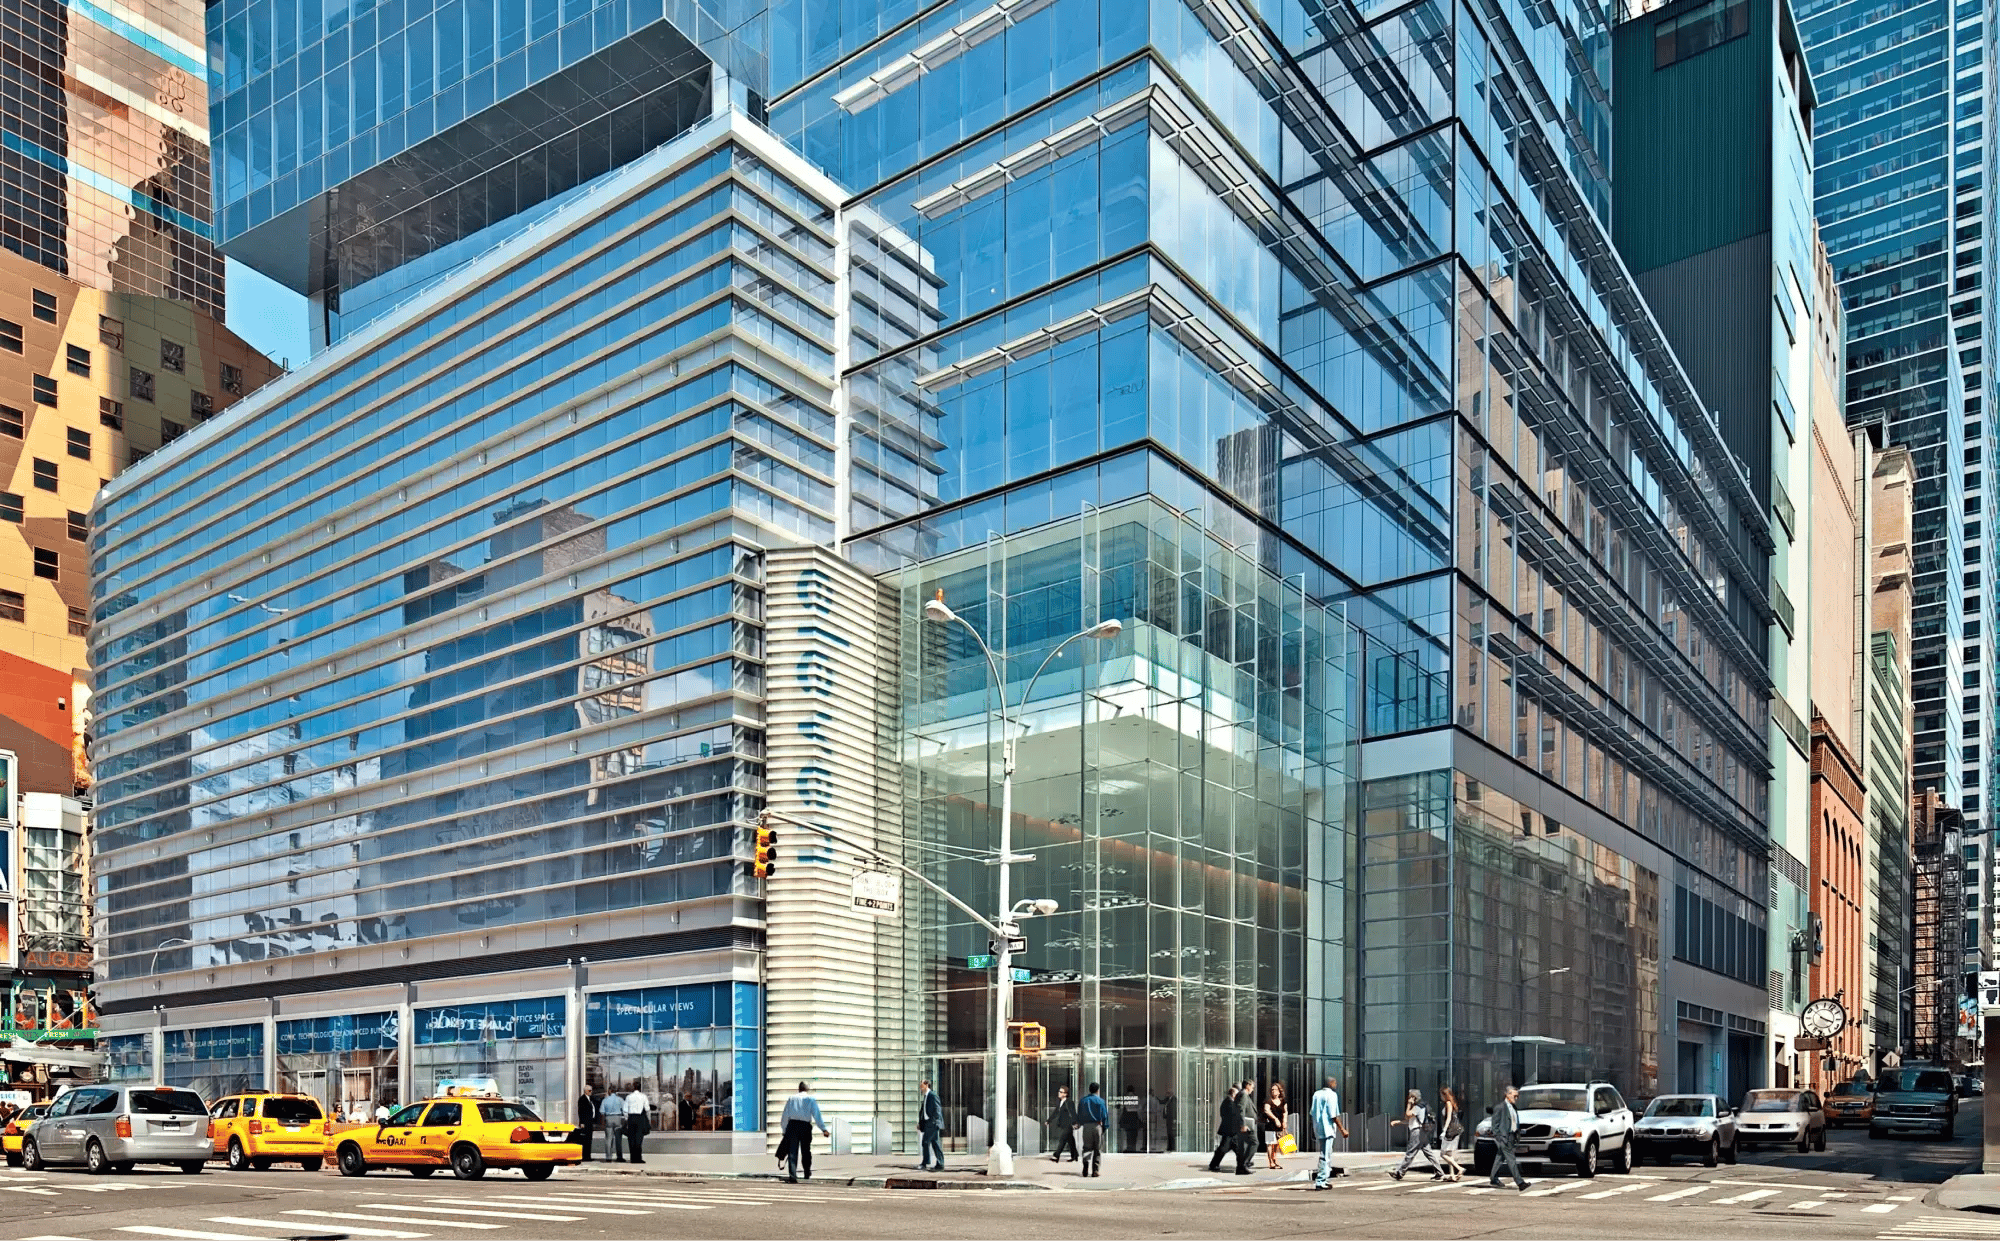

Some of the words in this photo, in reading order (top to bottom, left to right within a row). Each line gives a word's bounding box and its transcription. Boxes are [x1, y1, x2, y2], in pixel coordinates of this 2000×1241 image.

[669, 1001, 694, 1011] VIEWS
[510, 1014, 533, 1023] OFFICE
[534, 1012, 555, 1022] SPACE
